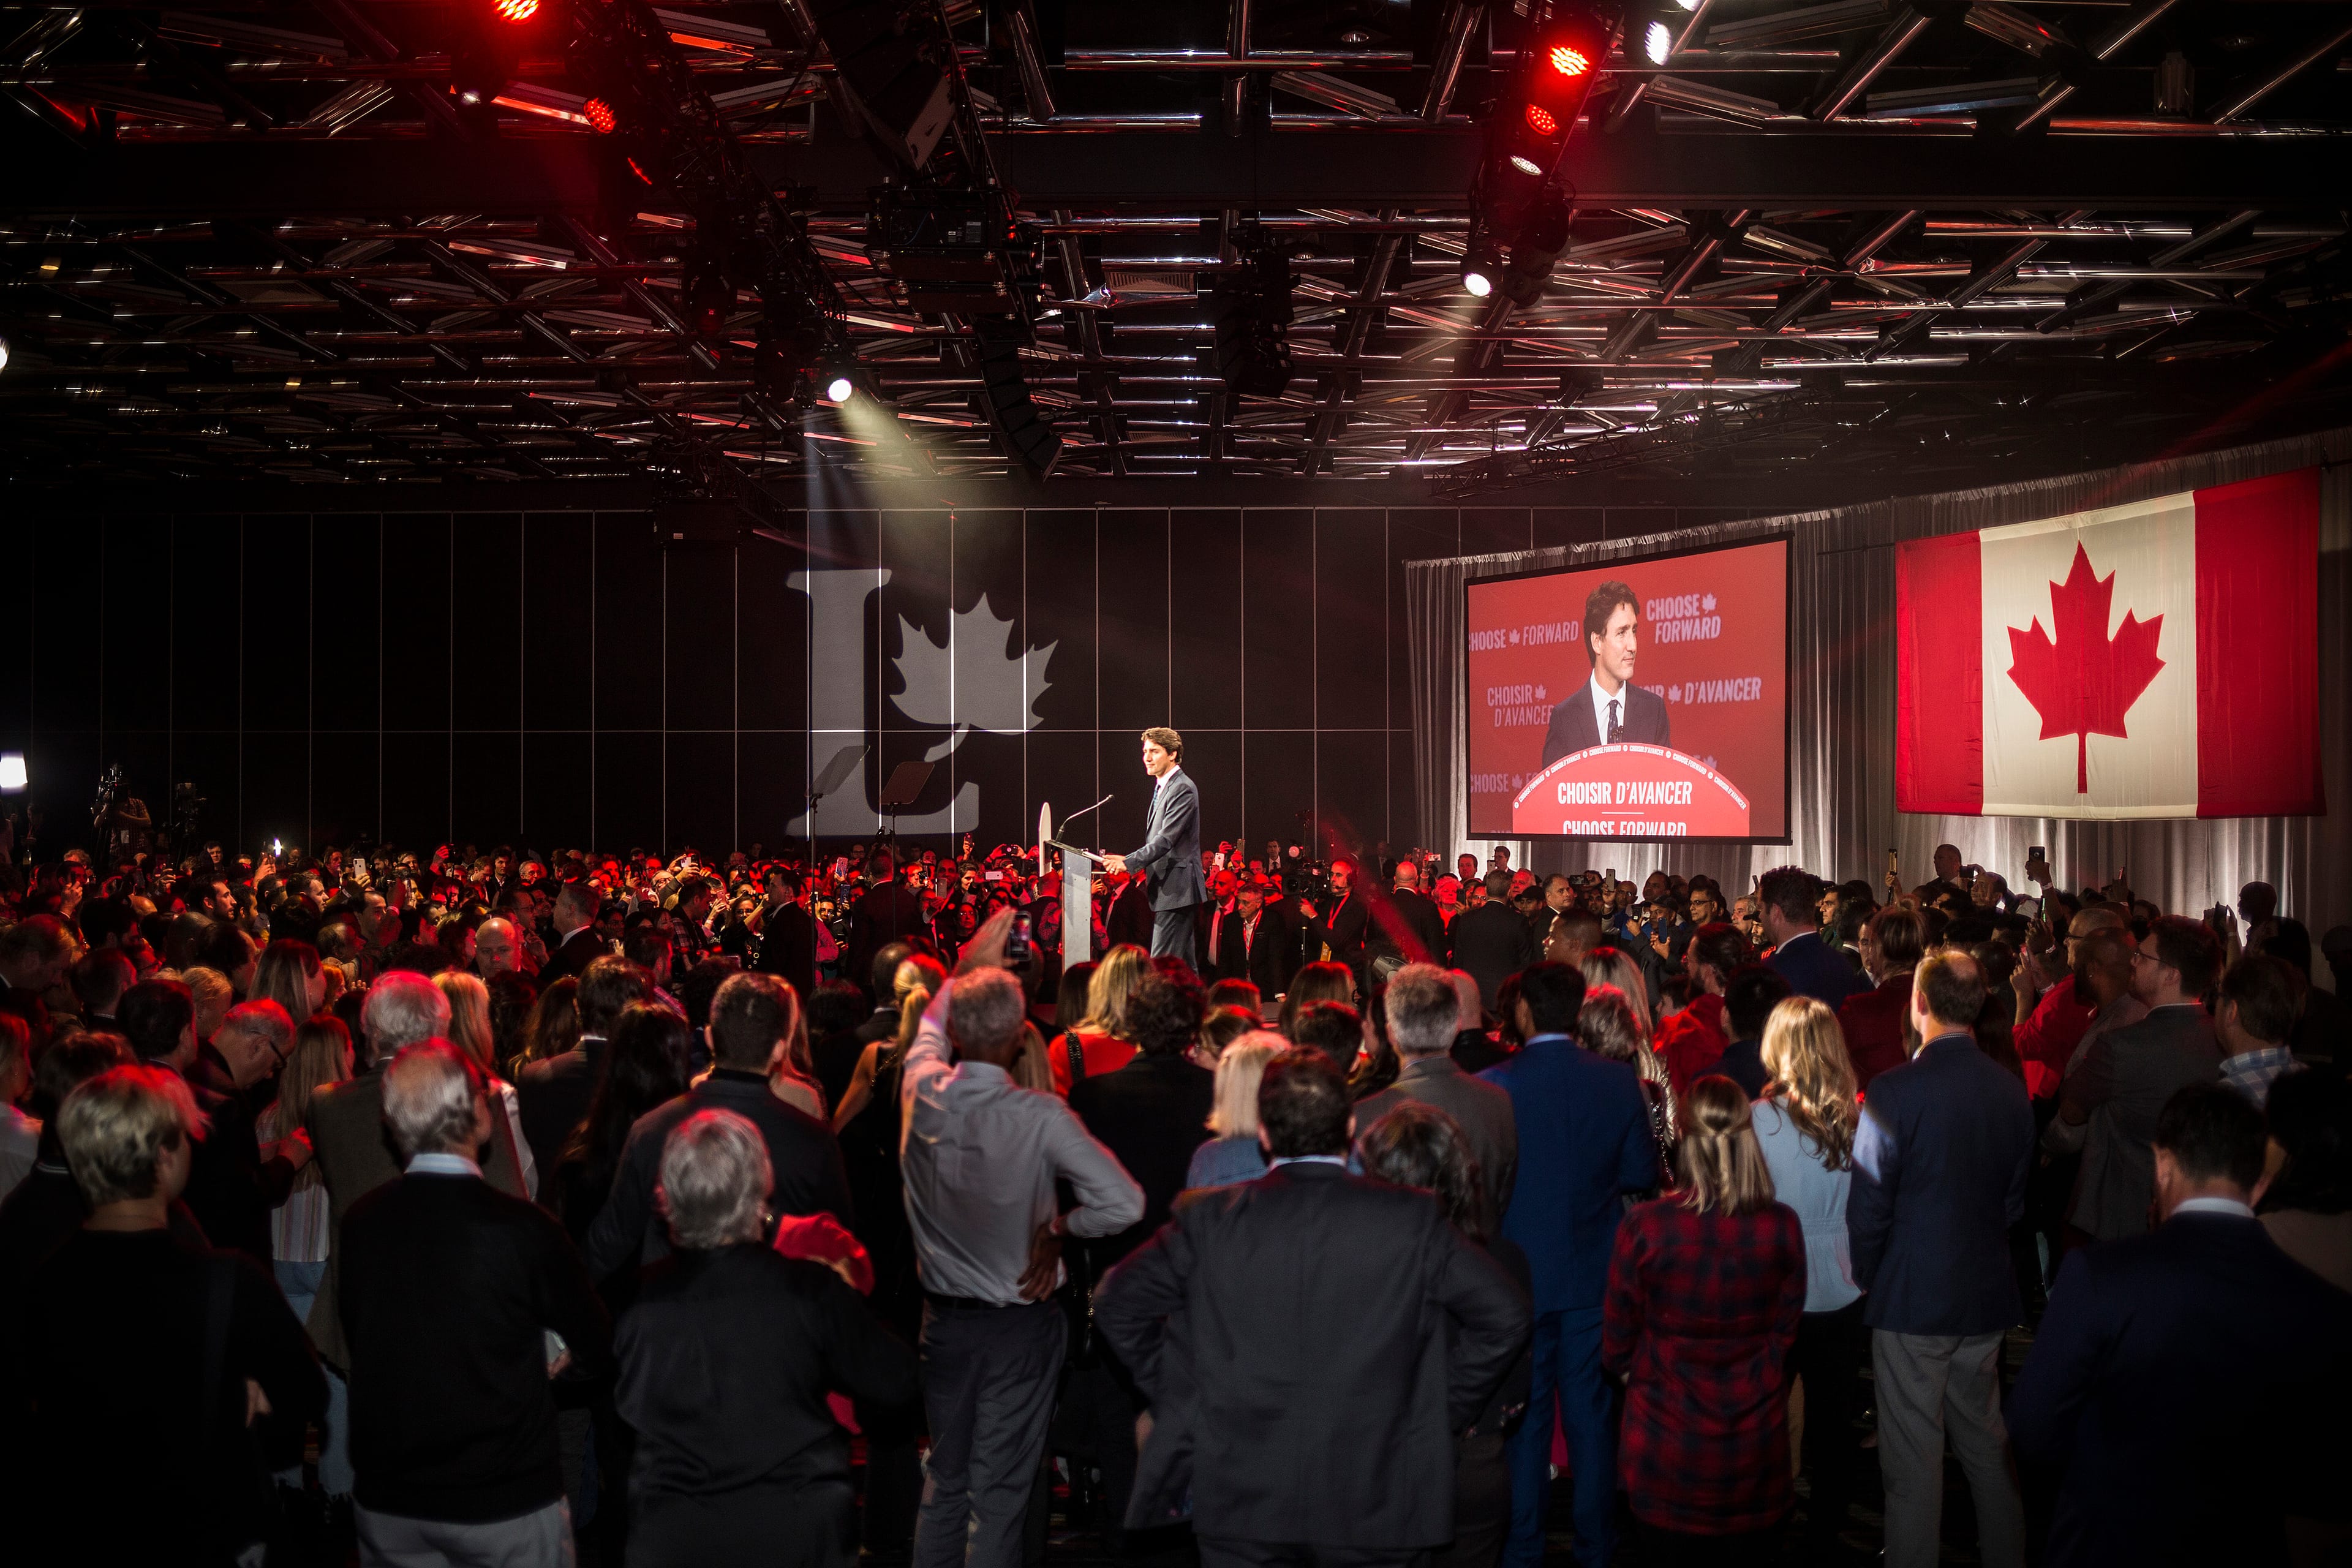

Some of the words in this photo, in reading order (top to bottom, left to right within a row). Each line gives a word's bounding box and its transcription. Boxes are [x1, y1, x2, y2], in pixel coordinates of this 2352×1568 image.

[1646, 594, 1700, 621] CHOOSE
[1469, 629, 1506, 652] HOOSE
[1522, 621, 1578, 646] FORWARD
[1655, 616, 1721, 644] FORWARD
[1487, 684, 1532, 706] CHOISIR
[1684, 677, 1762, 704] D'AVANCER
[1558, 782, 1611, 804] CHOISIR
[1616, 782, 1692, 804] D'AVANCER
[1563, 821, 1615, 835] CHOOSE
[1619, 821, 1687, 836] FORWARD
